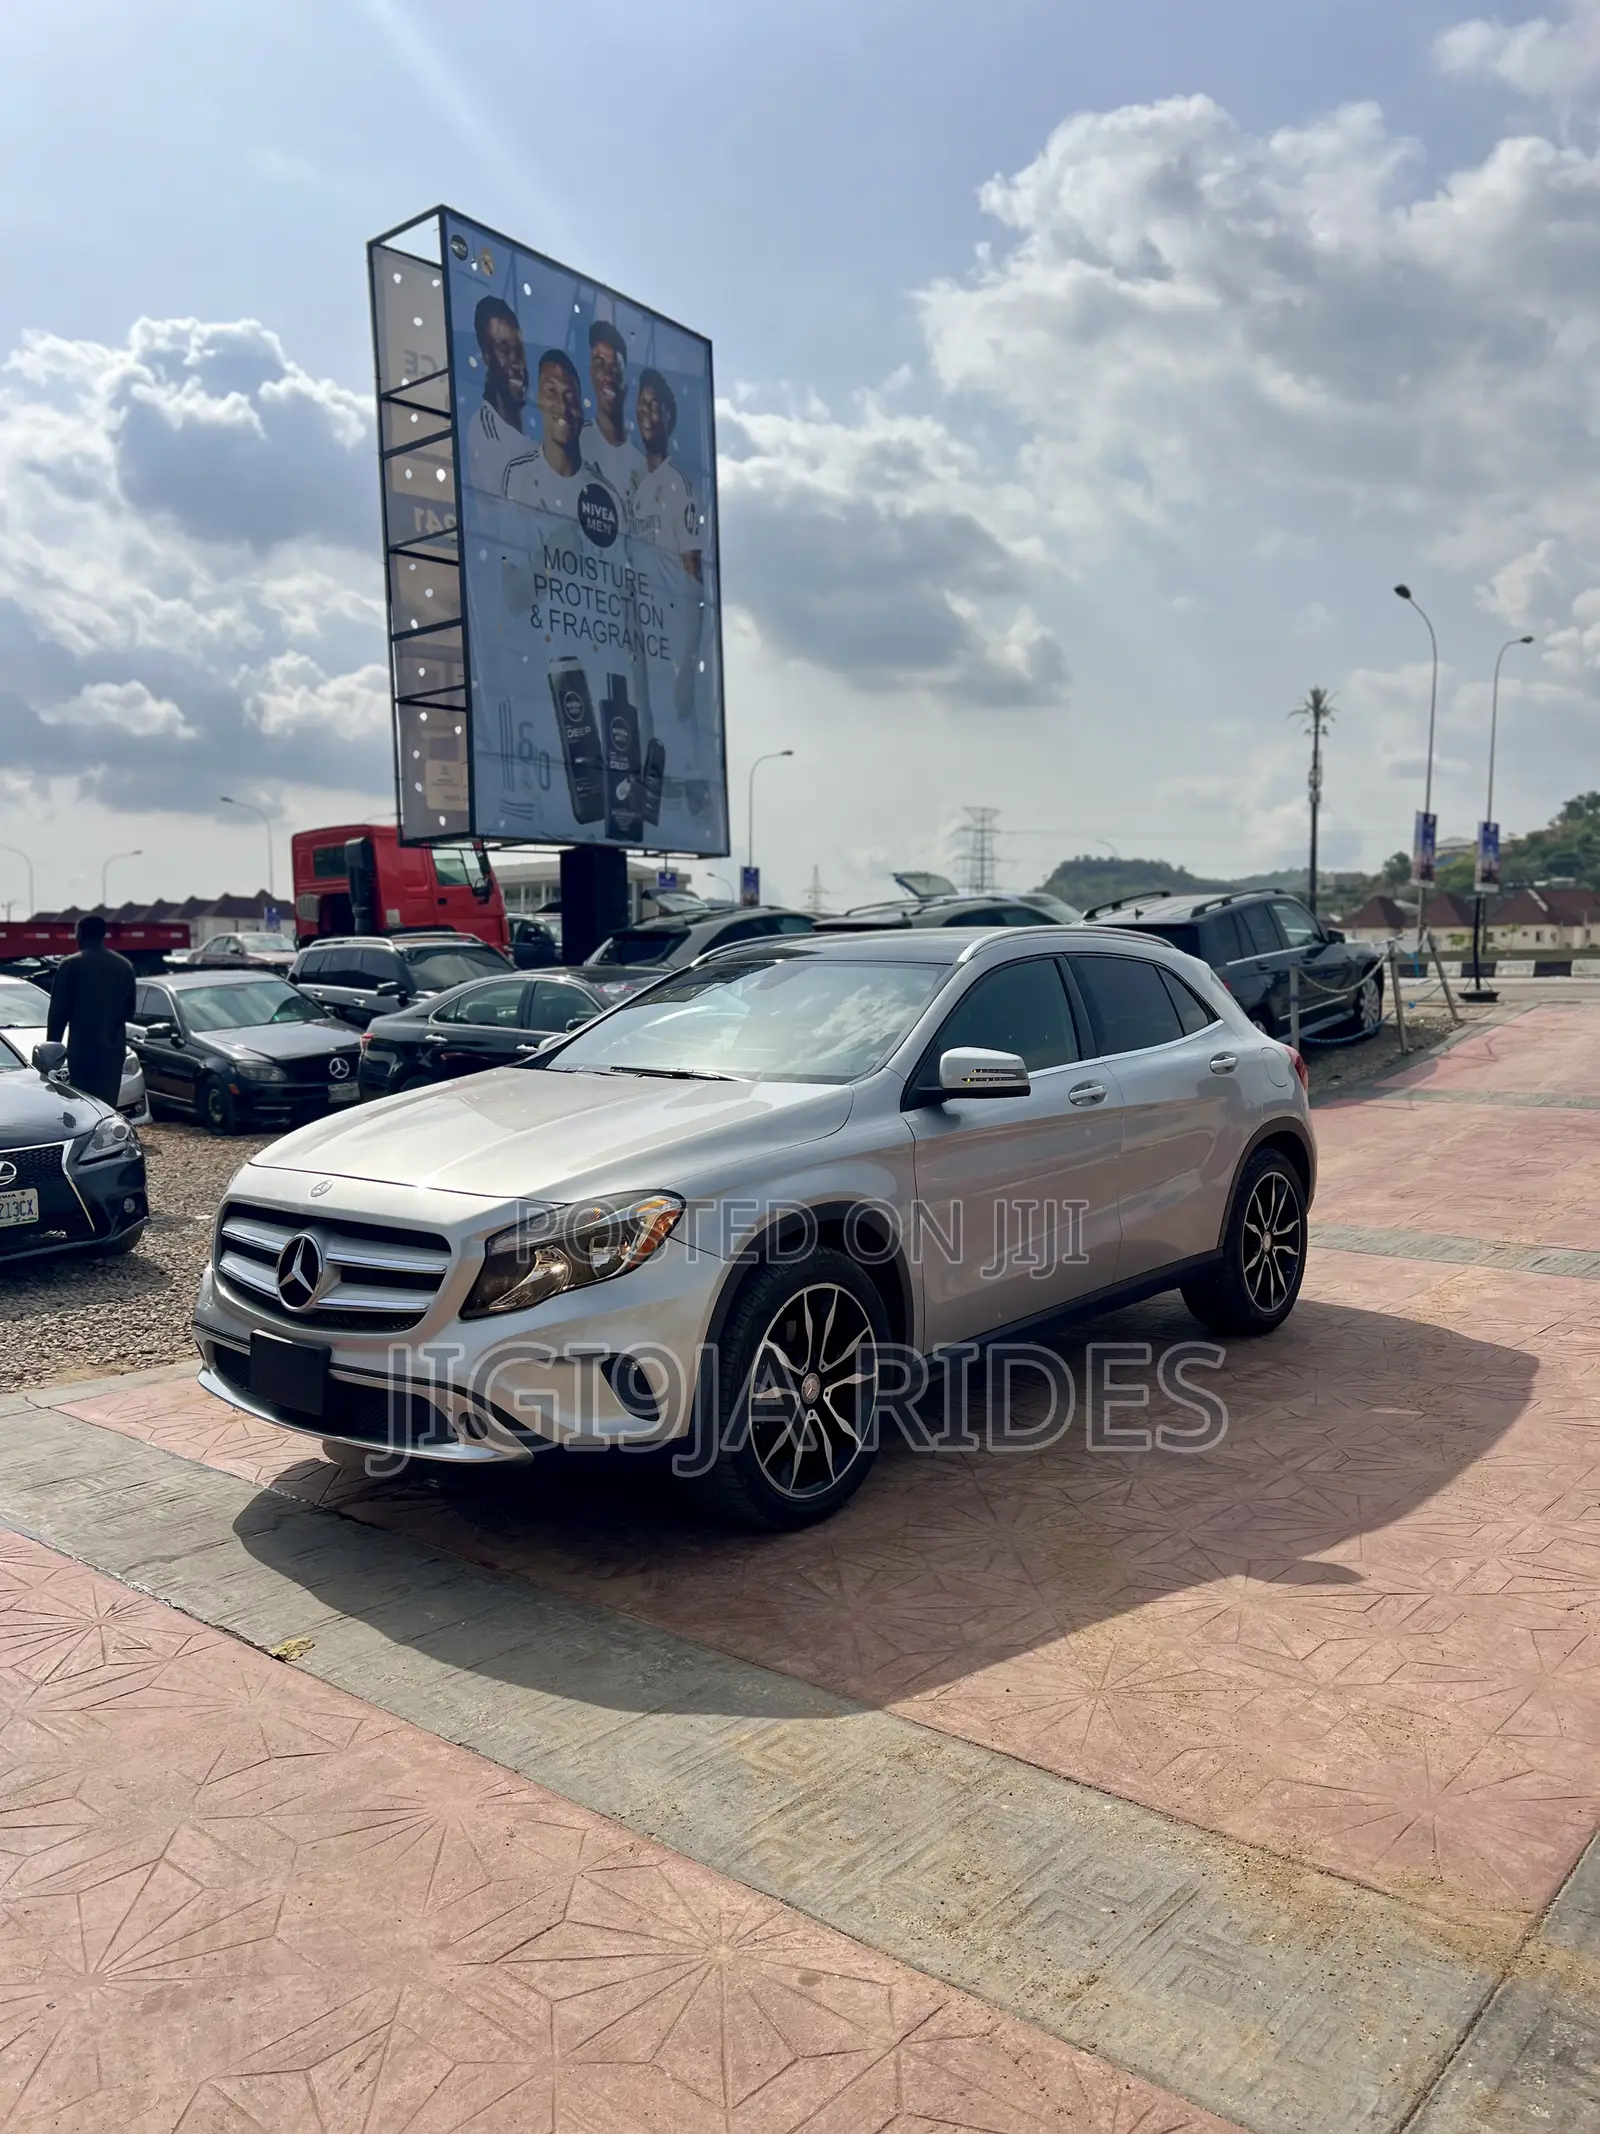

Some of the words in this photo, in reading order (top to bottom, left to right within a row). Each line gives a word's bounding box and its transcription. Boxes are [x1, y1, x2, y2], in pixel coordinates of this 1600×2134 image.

[581, 501, 616, 523] NIVEA
[586, 517, 612, 535] MEN
[533, 573, 664, 630] PROTECTION
[543, 544, 654, 602] MOISTURE,
[530, 604, 544, 629] &
[549, 608, 671, 661] FRAGRANCE
